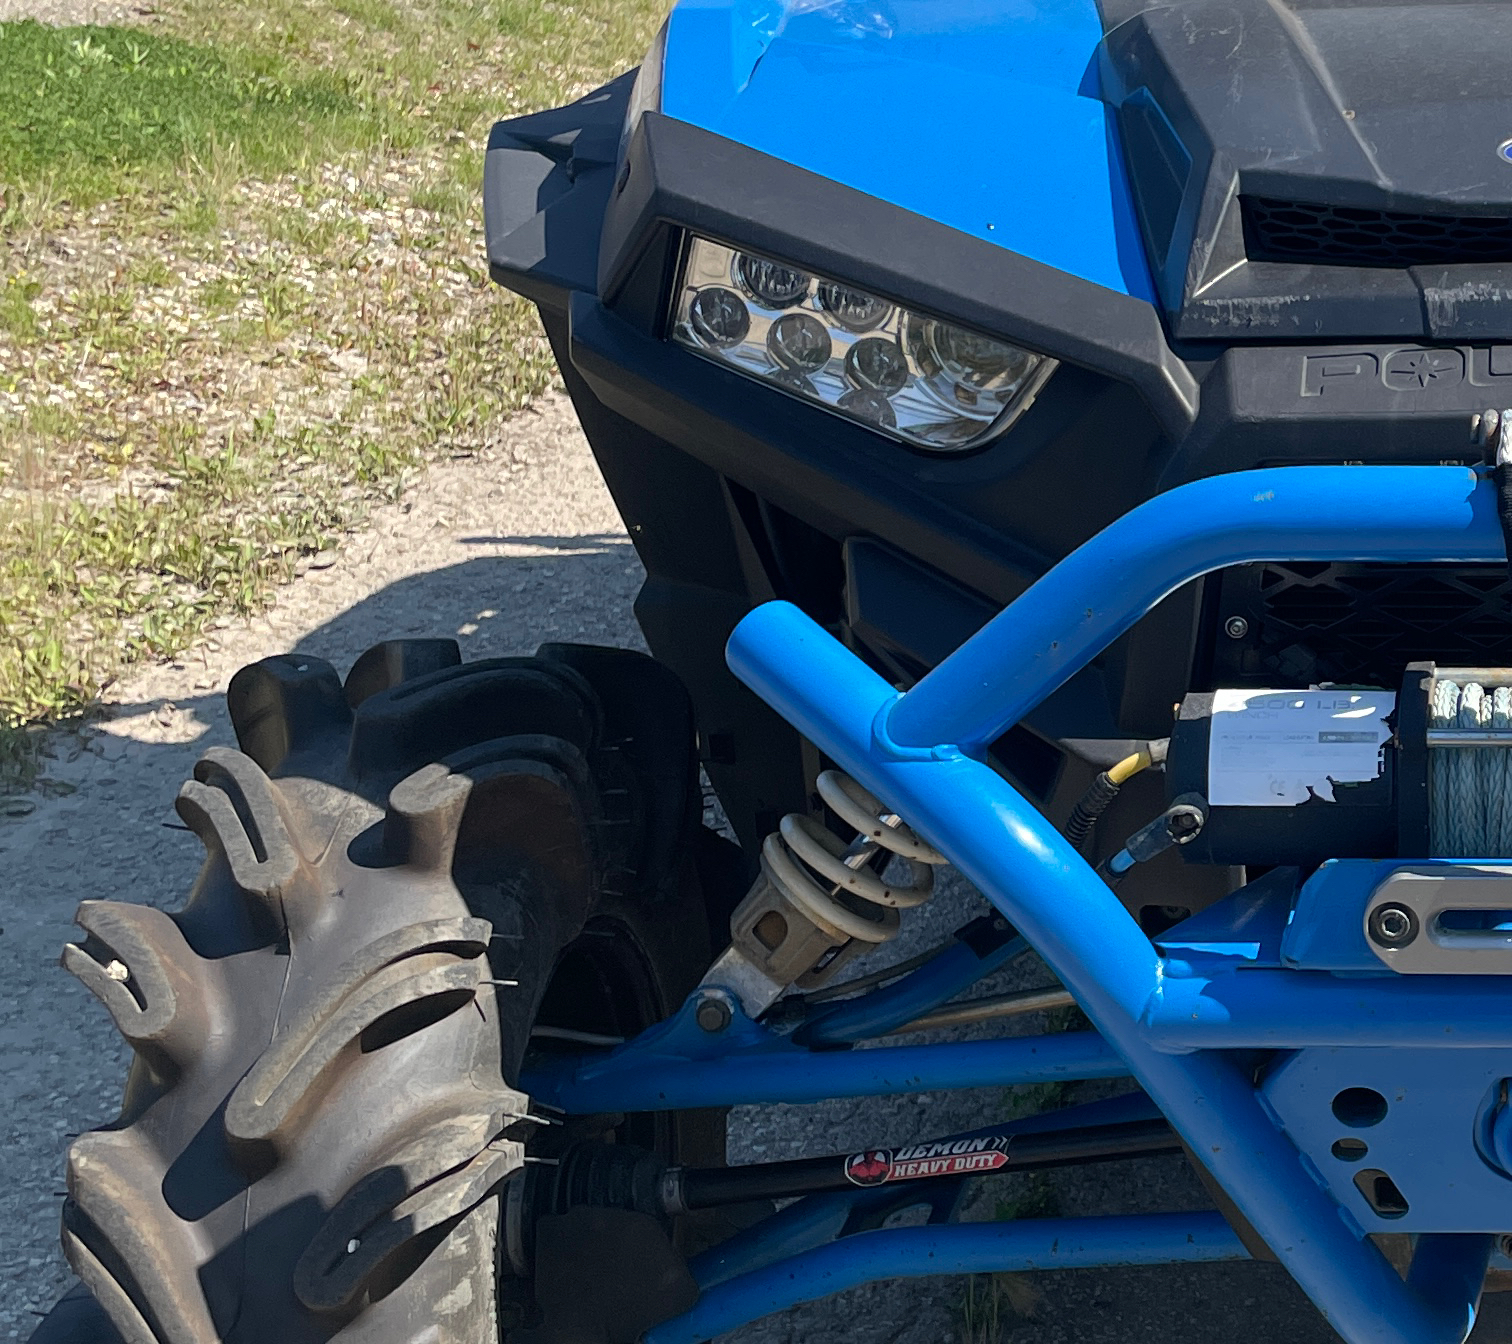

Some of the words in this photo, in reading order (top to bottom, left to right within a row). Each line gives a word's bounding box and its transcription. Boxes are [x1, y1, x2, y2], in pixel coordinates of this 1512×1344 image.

[894, 1136, 992, 1161] DEMON
[893, 1159, 952, 1177] HEAVY
[953, 1154, 998, 1171] DUTY
